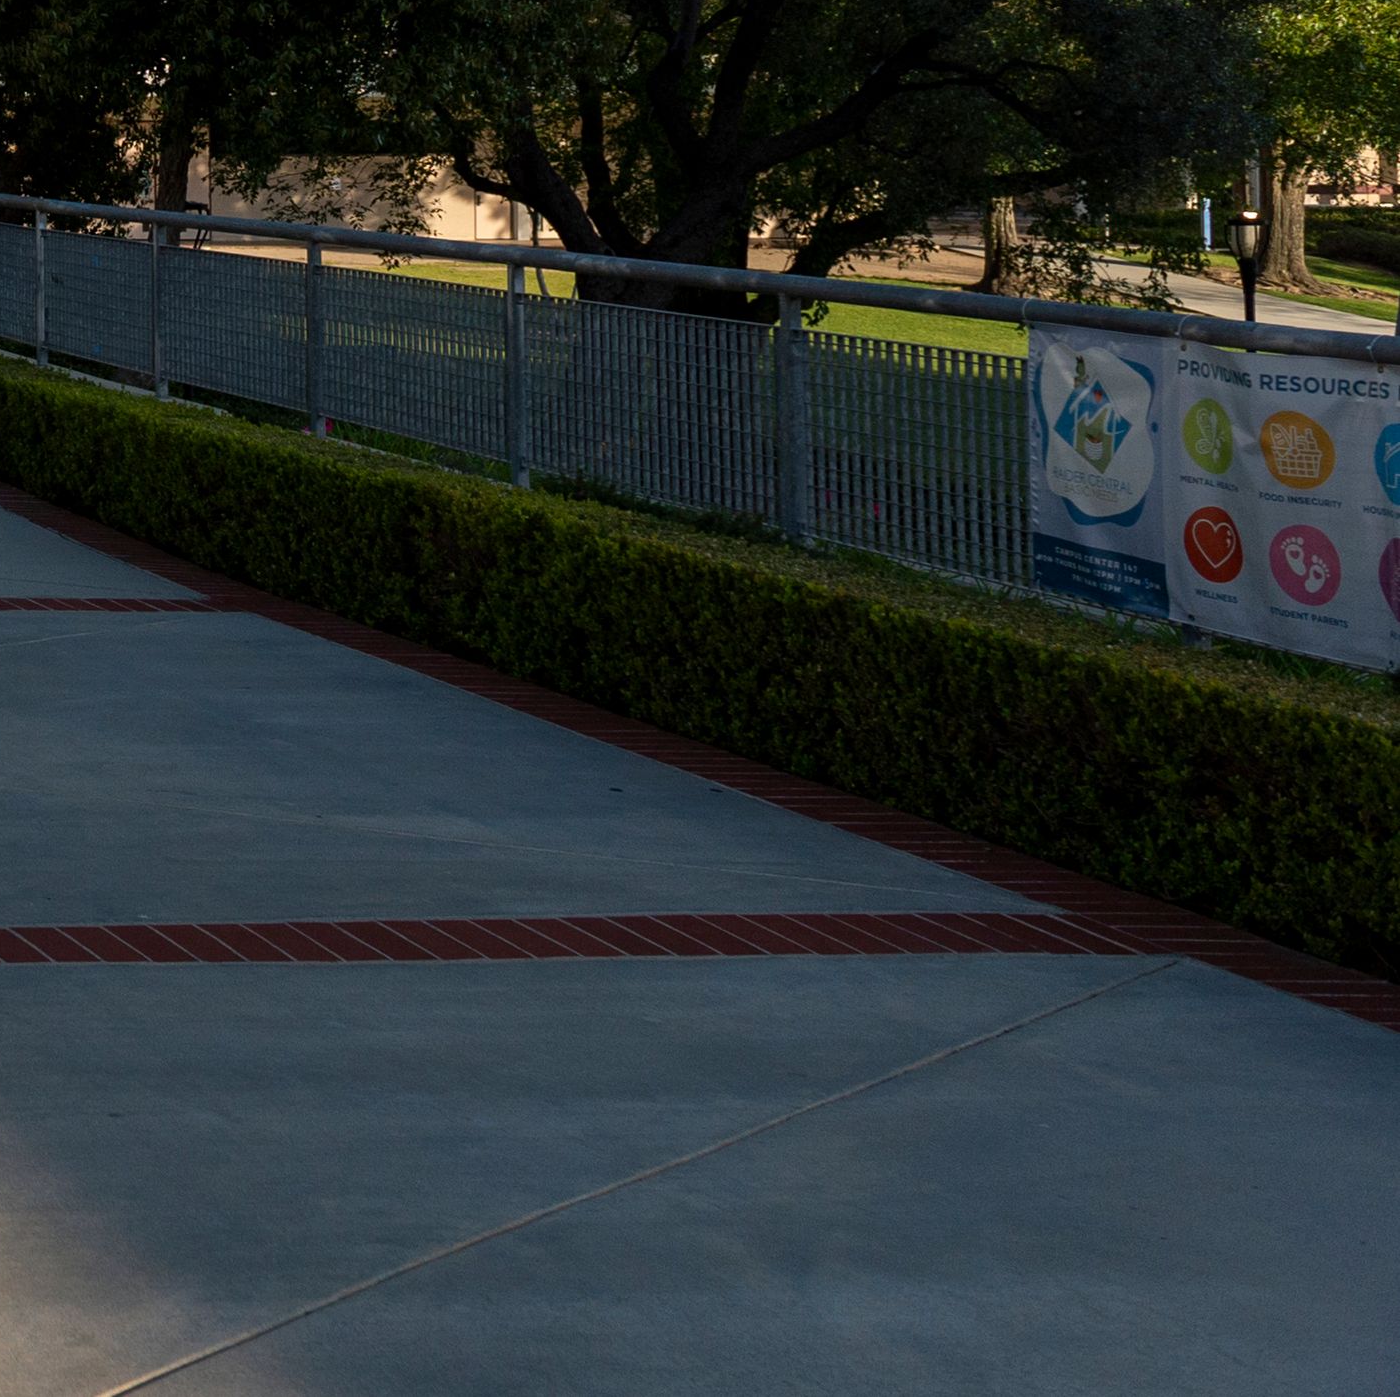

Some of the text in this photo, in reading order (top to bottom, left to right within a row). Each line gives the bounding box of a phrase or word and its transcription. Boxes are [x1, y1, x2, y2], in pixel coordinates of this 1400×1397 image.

[1177, 359, 1252, 389] PROVIDING
[1259, 373, 1390, 400] RESOURCES
[1180, 475, 1215, 488] MENTAL
[1259, 491, 1342, 509] FOOD INSECURITY
[1084, 554, 1120, 570] CENTER
[1195, 588, 1238, 604] WELLNESS
[1270, 606, 1349, 629] STUDENT PARENTS
